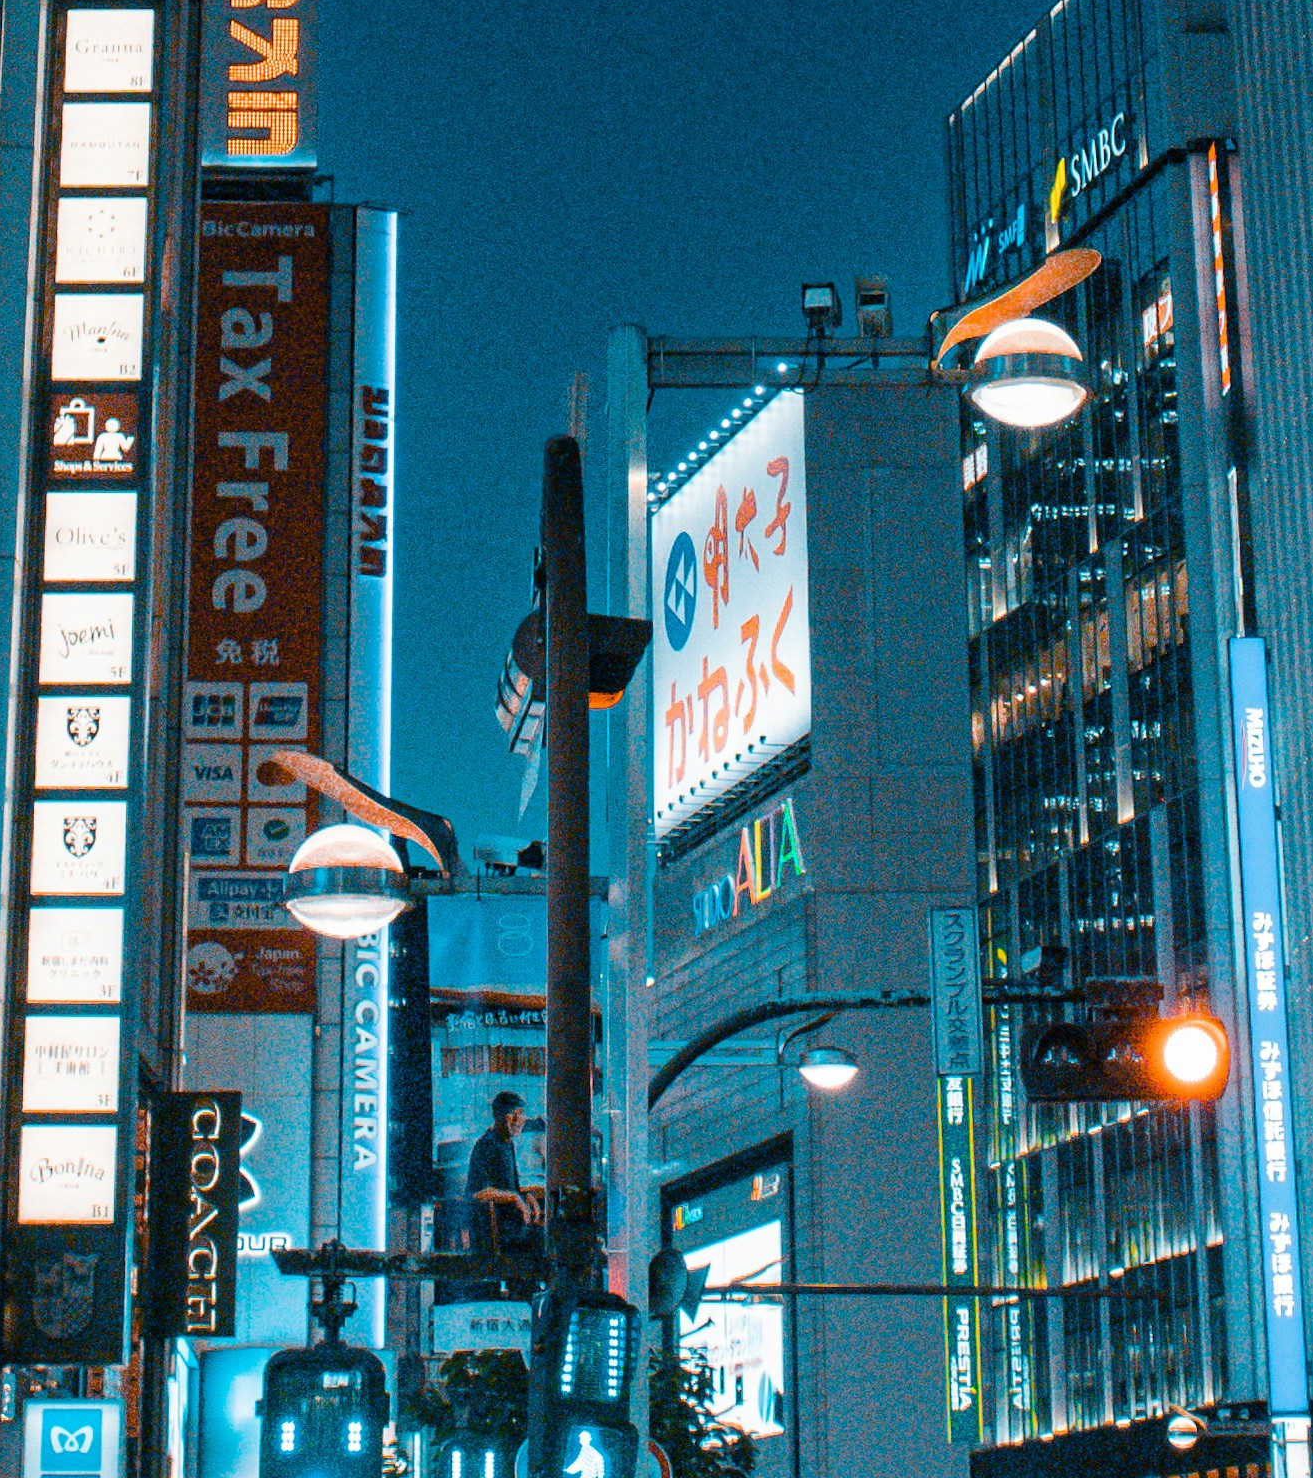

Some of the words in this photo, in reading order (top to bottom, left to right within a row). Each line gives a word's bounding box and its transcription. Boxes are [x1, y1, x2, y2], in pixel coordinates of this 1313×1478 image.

[1069, 111, 1127, 198] SMBC
[218, 254, 294, 403] Tax
[211, 429, 290, 614] Free
[664, 585, 796, 789] かねふく
[194, 765, 234, 781] VISA
[1244, 706, 1265, 792] MIZUHO
[732, 797, 807, 919] ALTA
[353, 932, 384, 989] BIC
[1253, 911, 1279, 1012] みずほ証券
[353, 1002, 384, 1172] CAMERA
[1259, 1041, 1287, 1183] みずほ信託銀行
[187, 1108, 222, 1334] COACH
[1268, 1211, 1296, 1319] みずほ銀行
